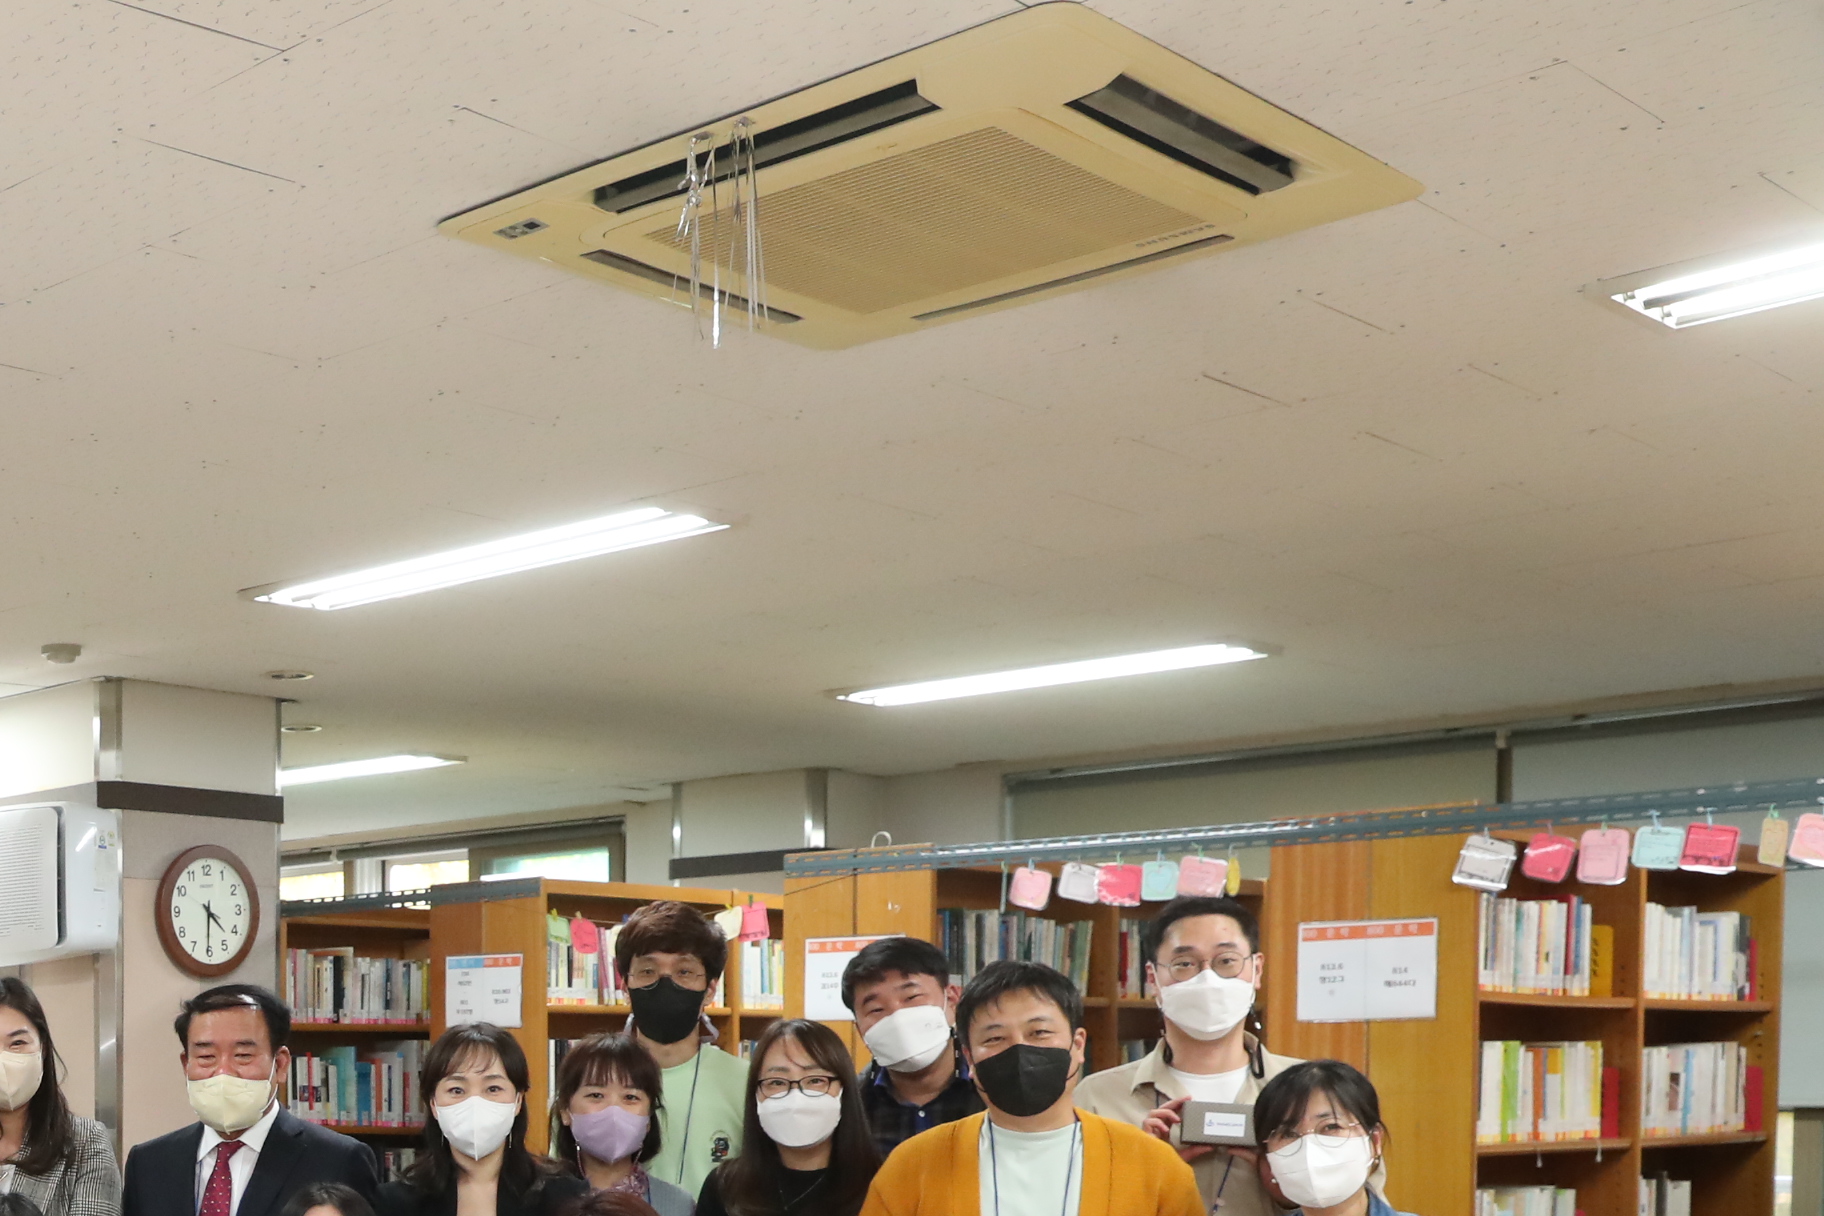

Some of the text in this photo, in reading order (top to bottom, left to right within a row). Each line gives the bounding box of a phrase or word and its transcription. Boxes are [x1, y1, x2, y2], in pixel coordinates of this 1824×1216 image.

[187, 870, 195, 881] 11
[201, 865, 211, 876] 12
[220, 870, 224, 881] 1
[176, 885, 186, 896] 10
[230, 884, 237, 896] 2
[174, 906, 180, 917] 9
[235, 904, 241, 915] 3
[179, 927, 186, 938] 8
[231, 925, 238, 935] 4
[191, 941, 197, 952] 7
[221, 940, 228, 951] 5
